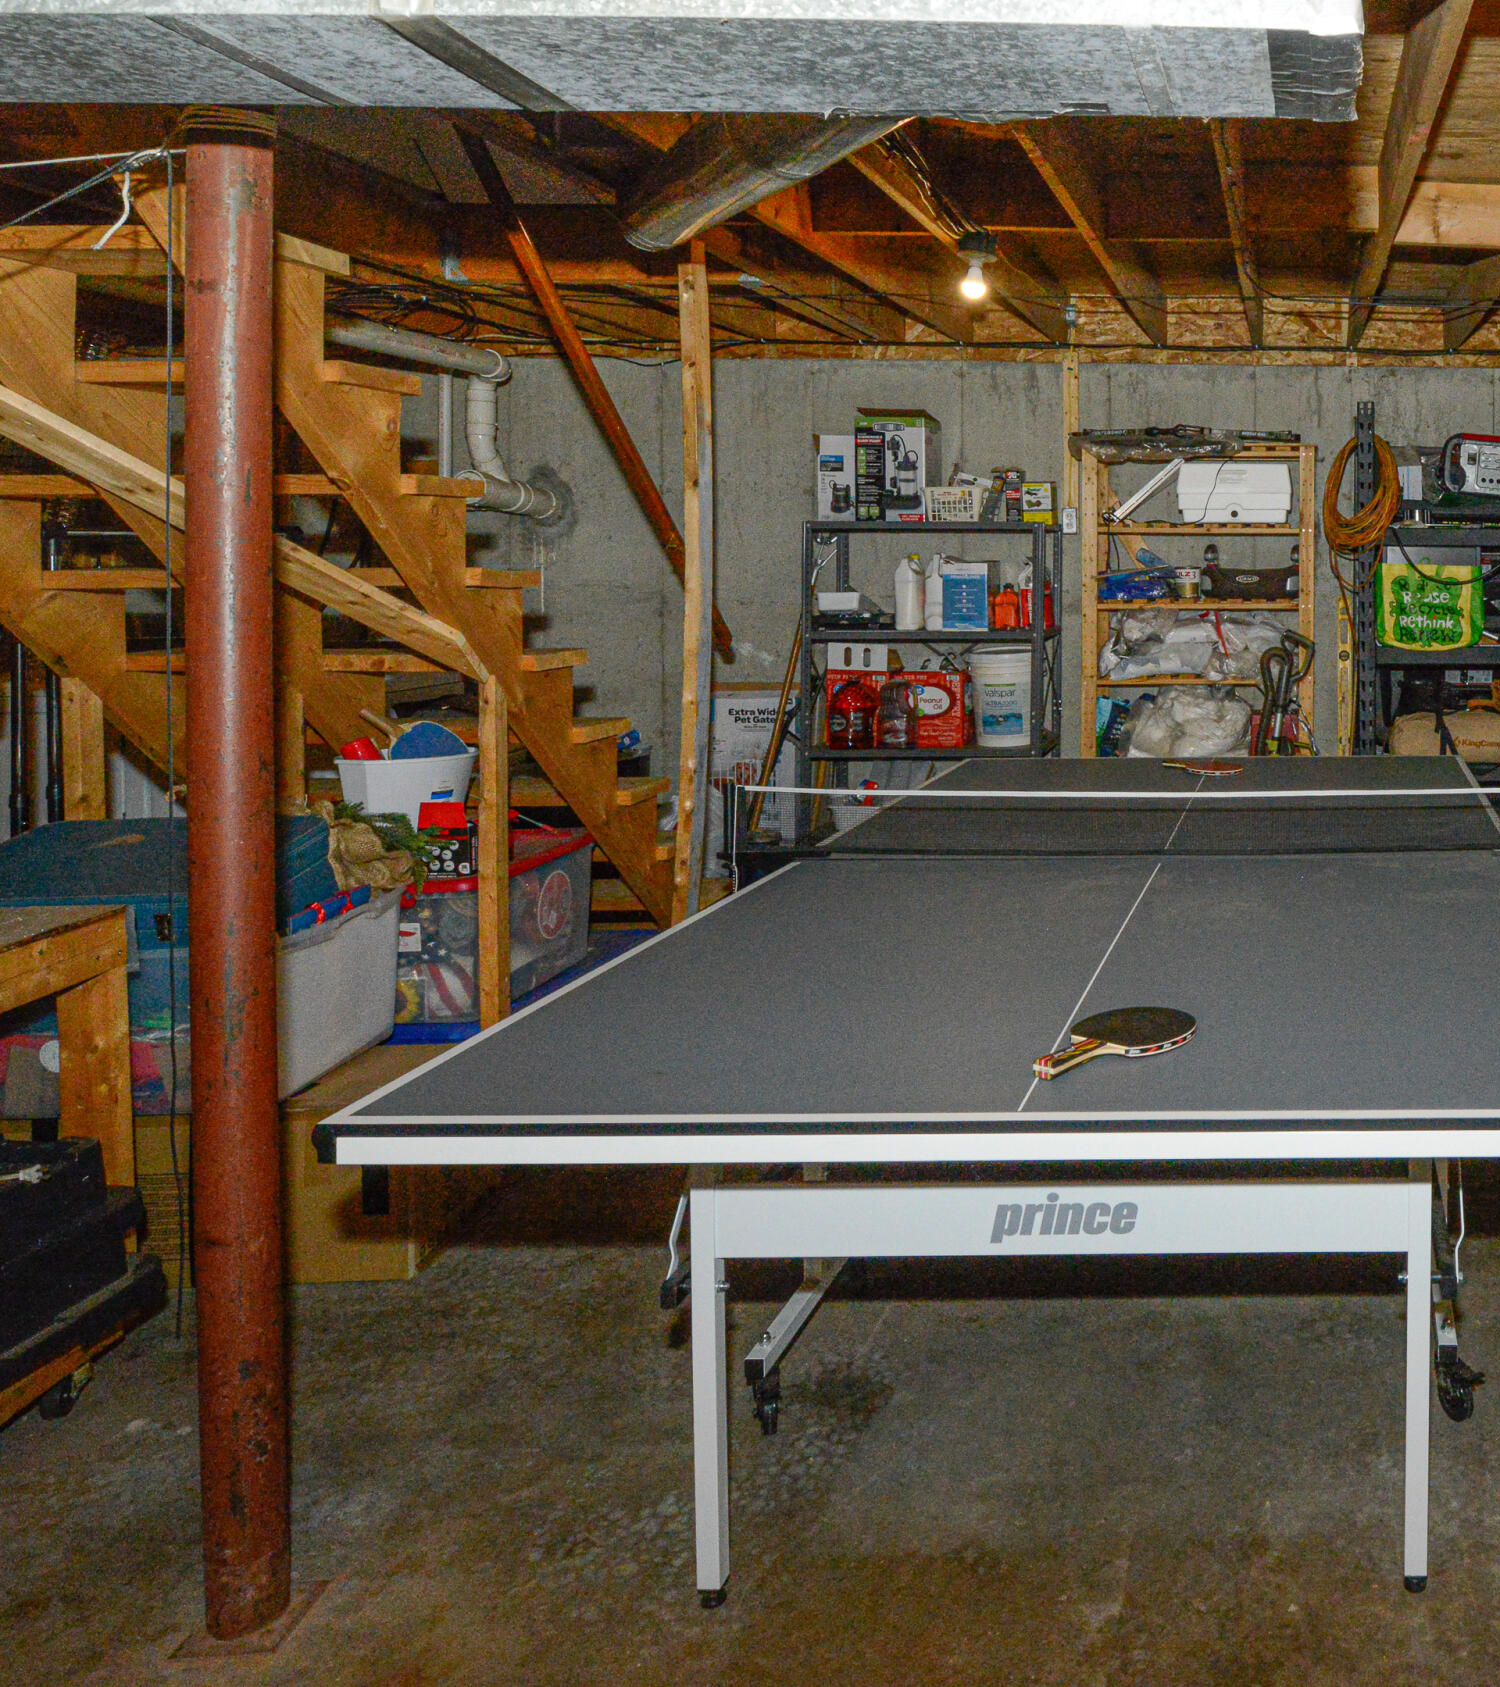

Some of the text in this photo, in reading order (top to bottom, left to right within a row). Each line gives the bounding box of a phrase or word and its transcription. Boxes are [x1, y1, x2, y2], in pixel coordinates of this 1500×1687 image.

[1400, 615, 1454, 629] Rethink
[728, 707, 778, 716] Extra Wid
[734, 716, 751, 724] Pet
[990, 1192, 1139, 1244] prince
